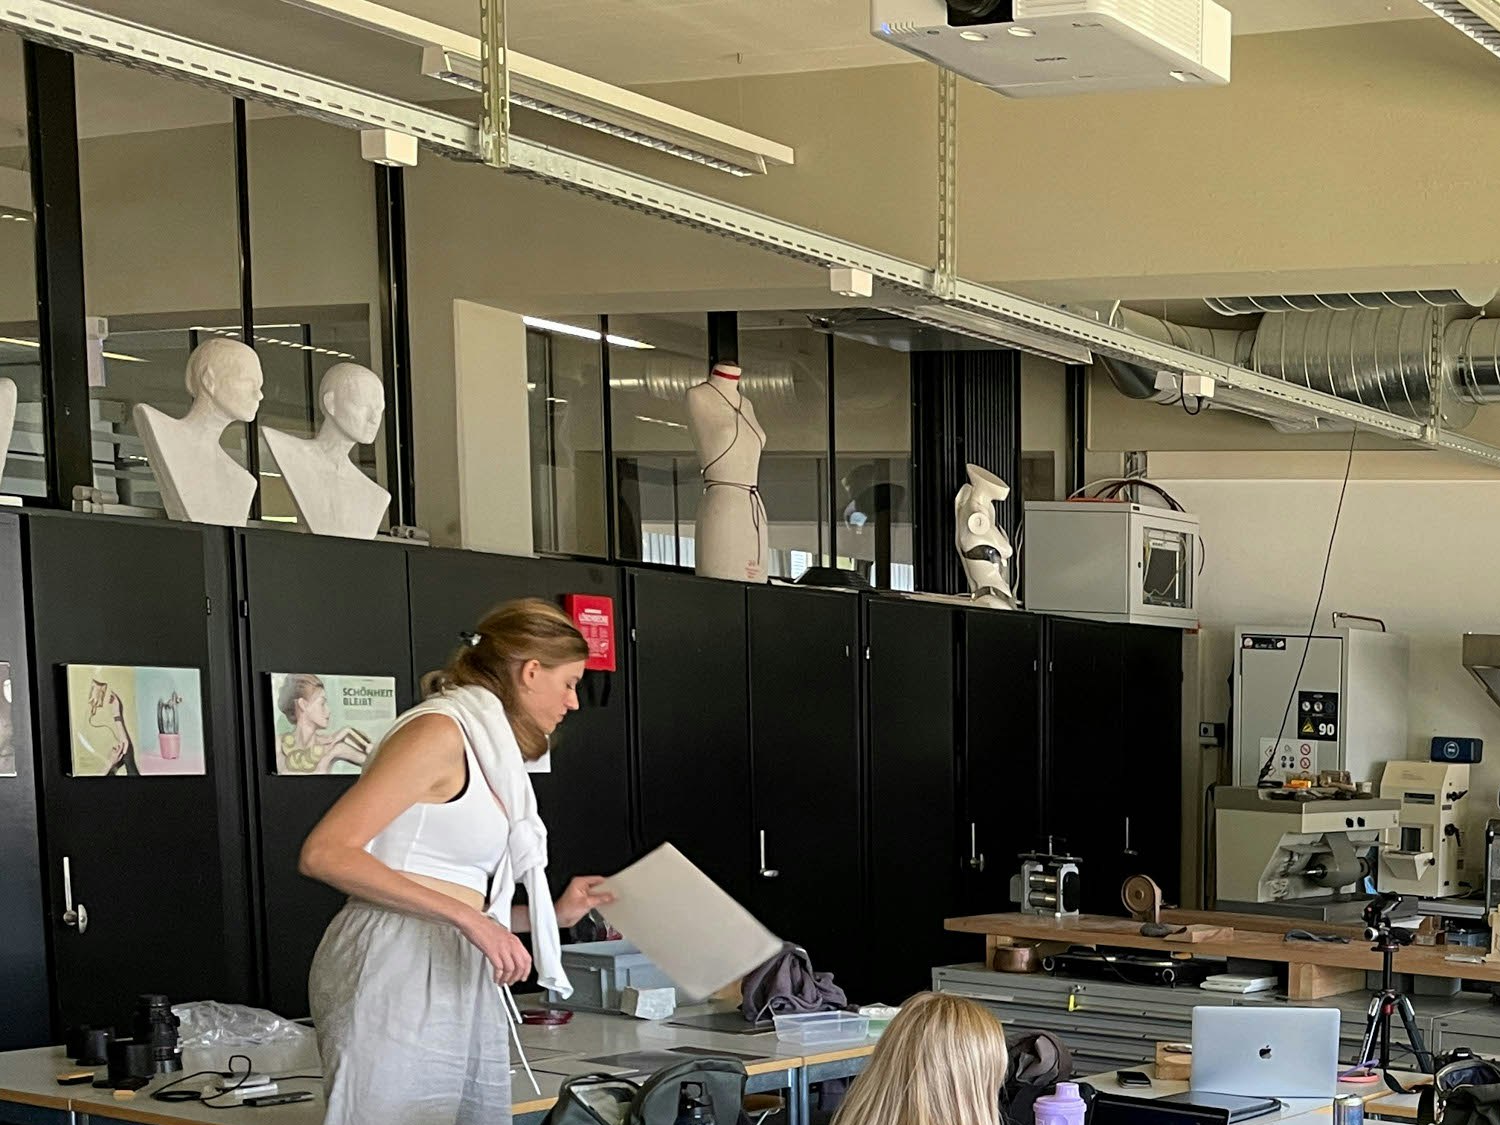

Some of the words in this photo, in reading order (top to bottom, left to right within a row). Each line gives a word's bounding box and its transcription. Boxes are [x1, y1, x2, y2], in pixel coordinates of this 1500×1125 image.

[342, 686, 393, 698] SCHÖNHEIT
[342, 697, 373, 706] BLEIBT
[1318, 723, 1335, 736] 90
